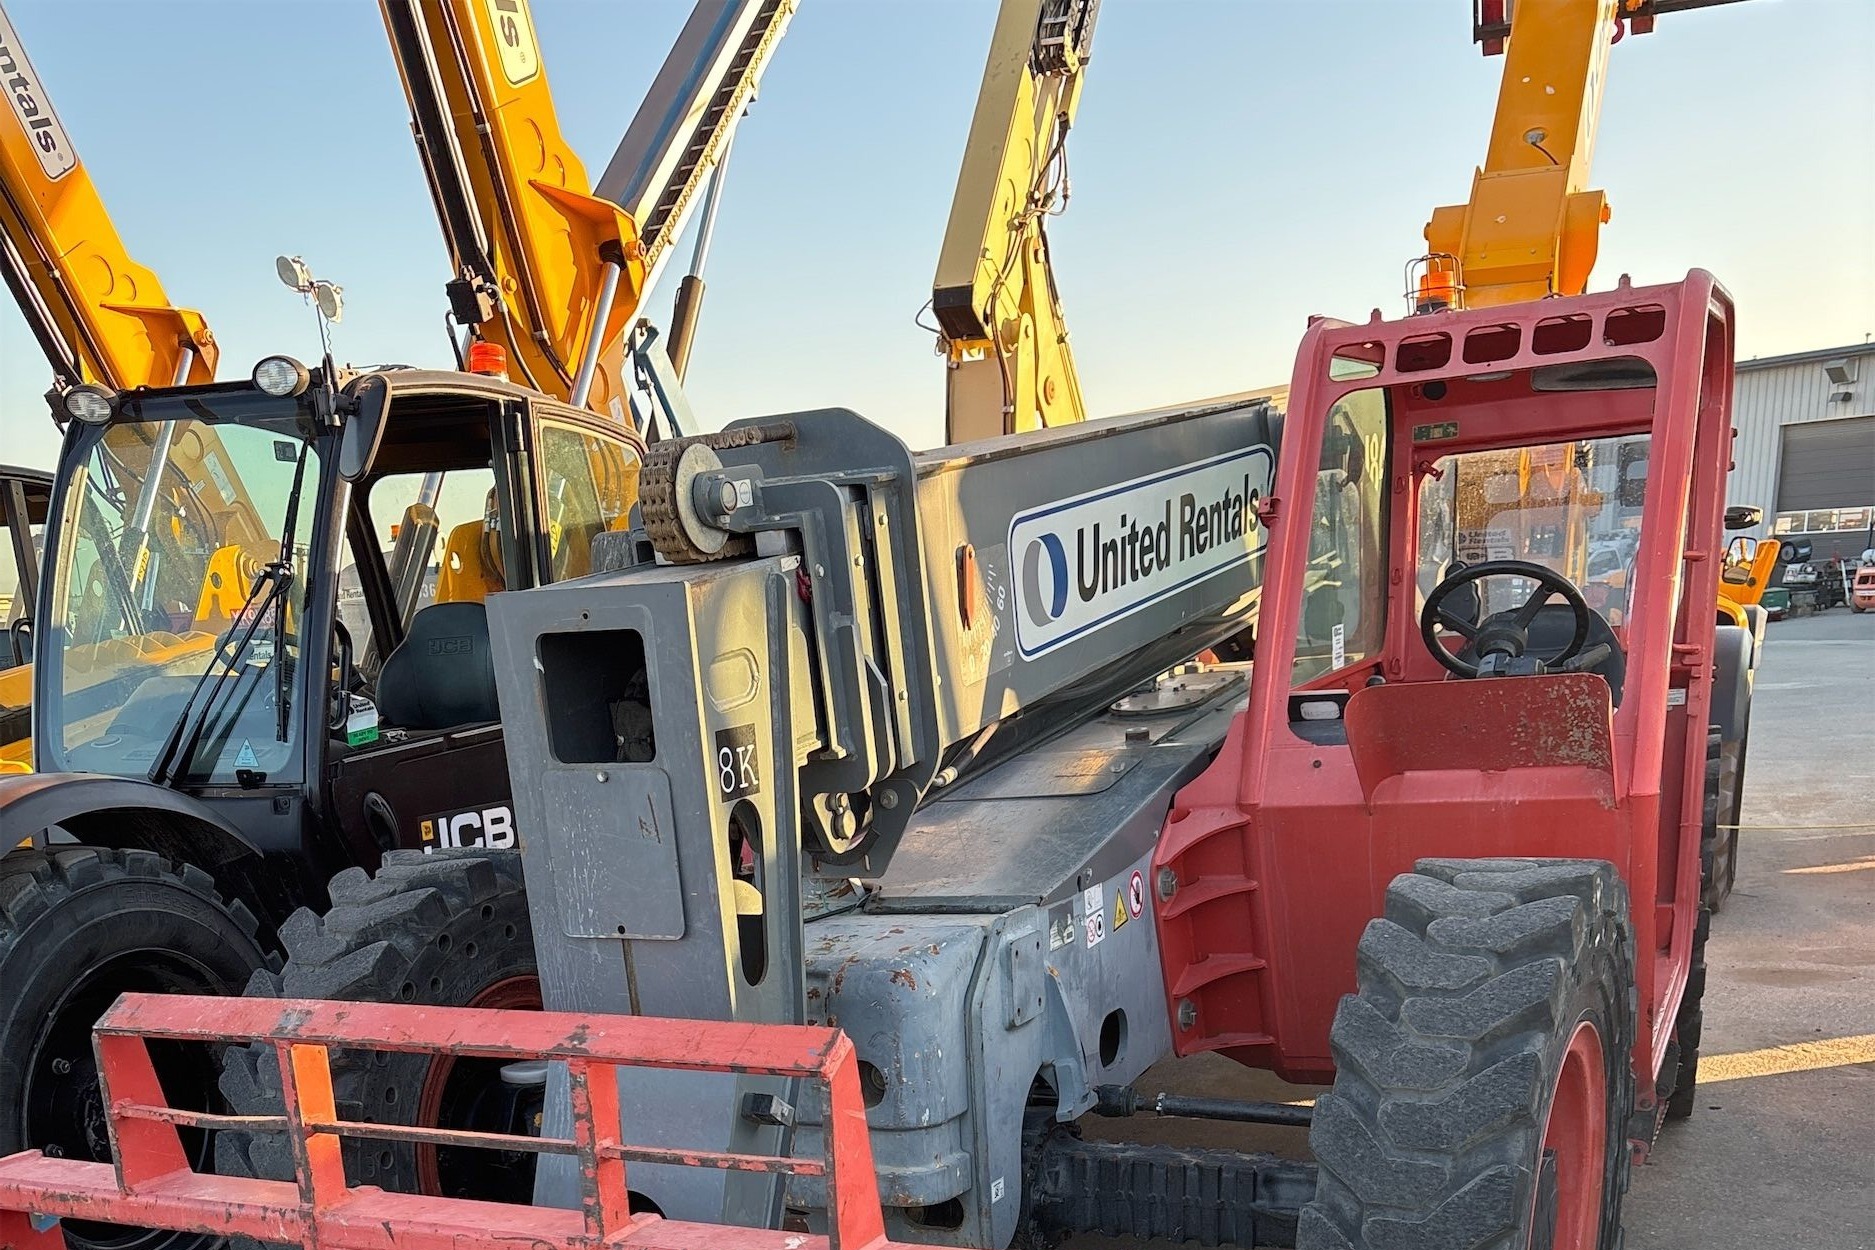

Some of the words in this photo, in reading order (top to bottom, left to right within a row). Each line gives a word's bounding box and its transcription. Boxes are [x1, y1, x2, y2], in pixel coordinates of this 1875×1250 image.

[0, 34, 57, 153] ntals
[1077, 499, 1171, 603] United
[1179, 474, 1259, 562] Rentals
[430, 638, 474, 655] JCB
[353, 701, 370, 709] United
[356, 706, 374, 714] Rentals
[719, 744, 759, 793] 8K
[423, 806, 515, 855] JCB
